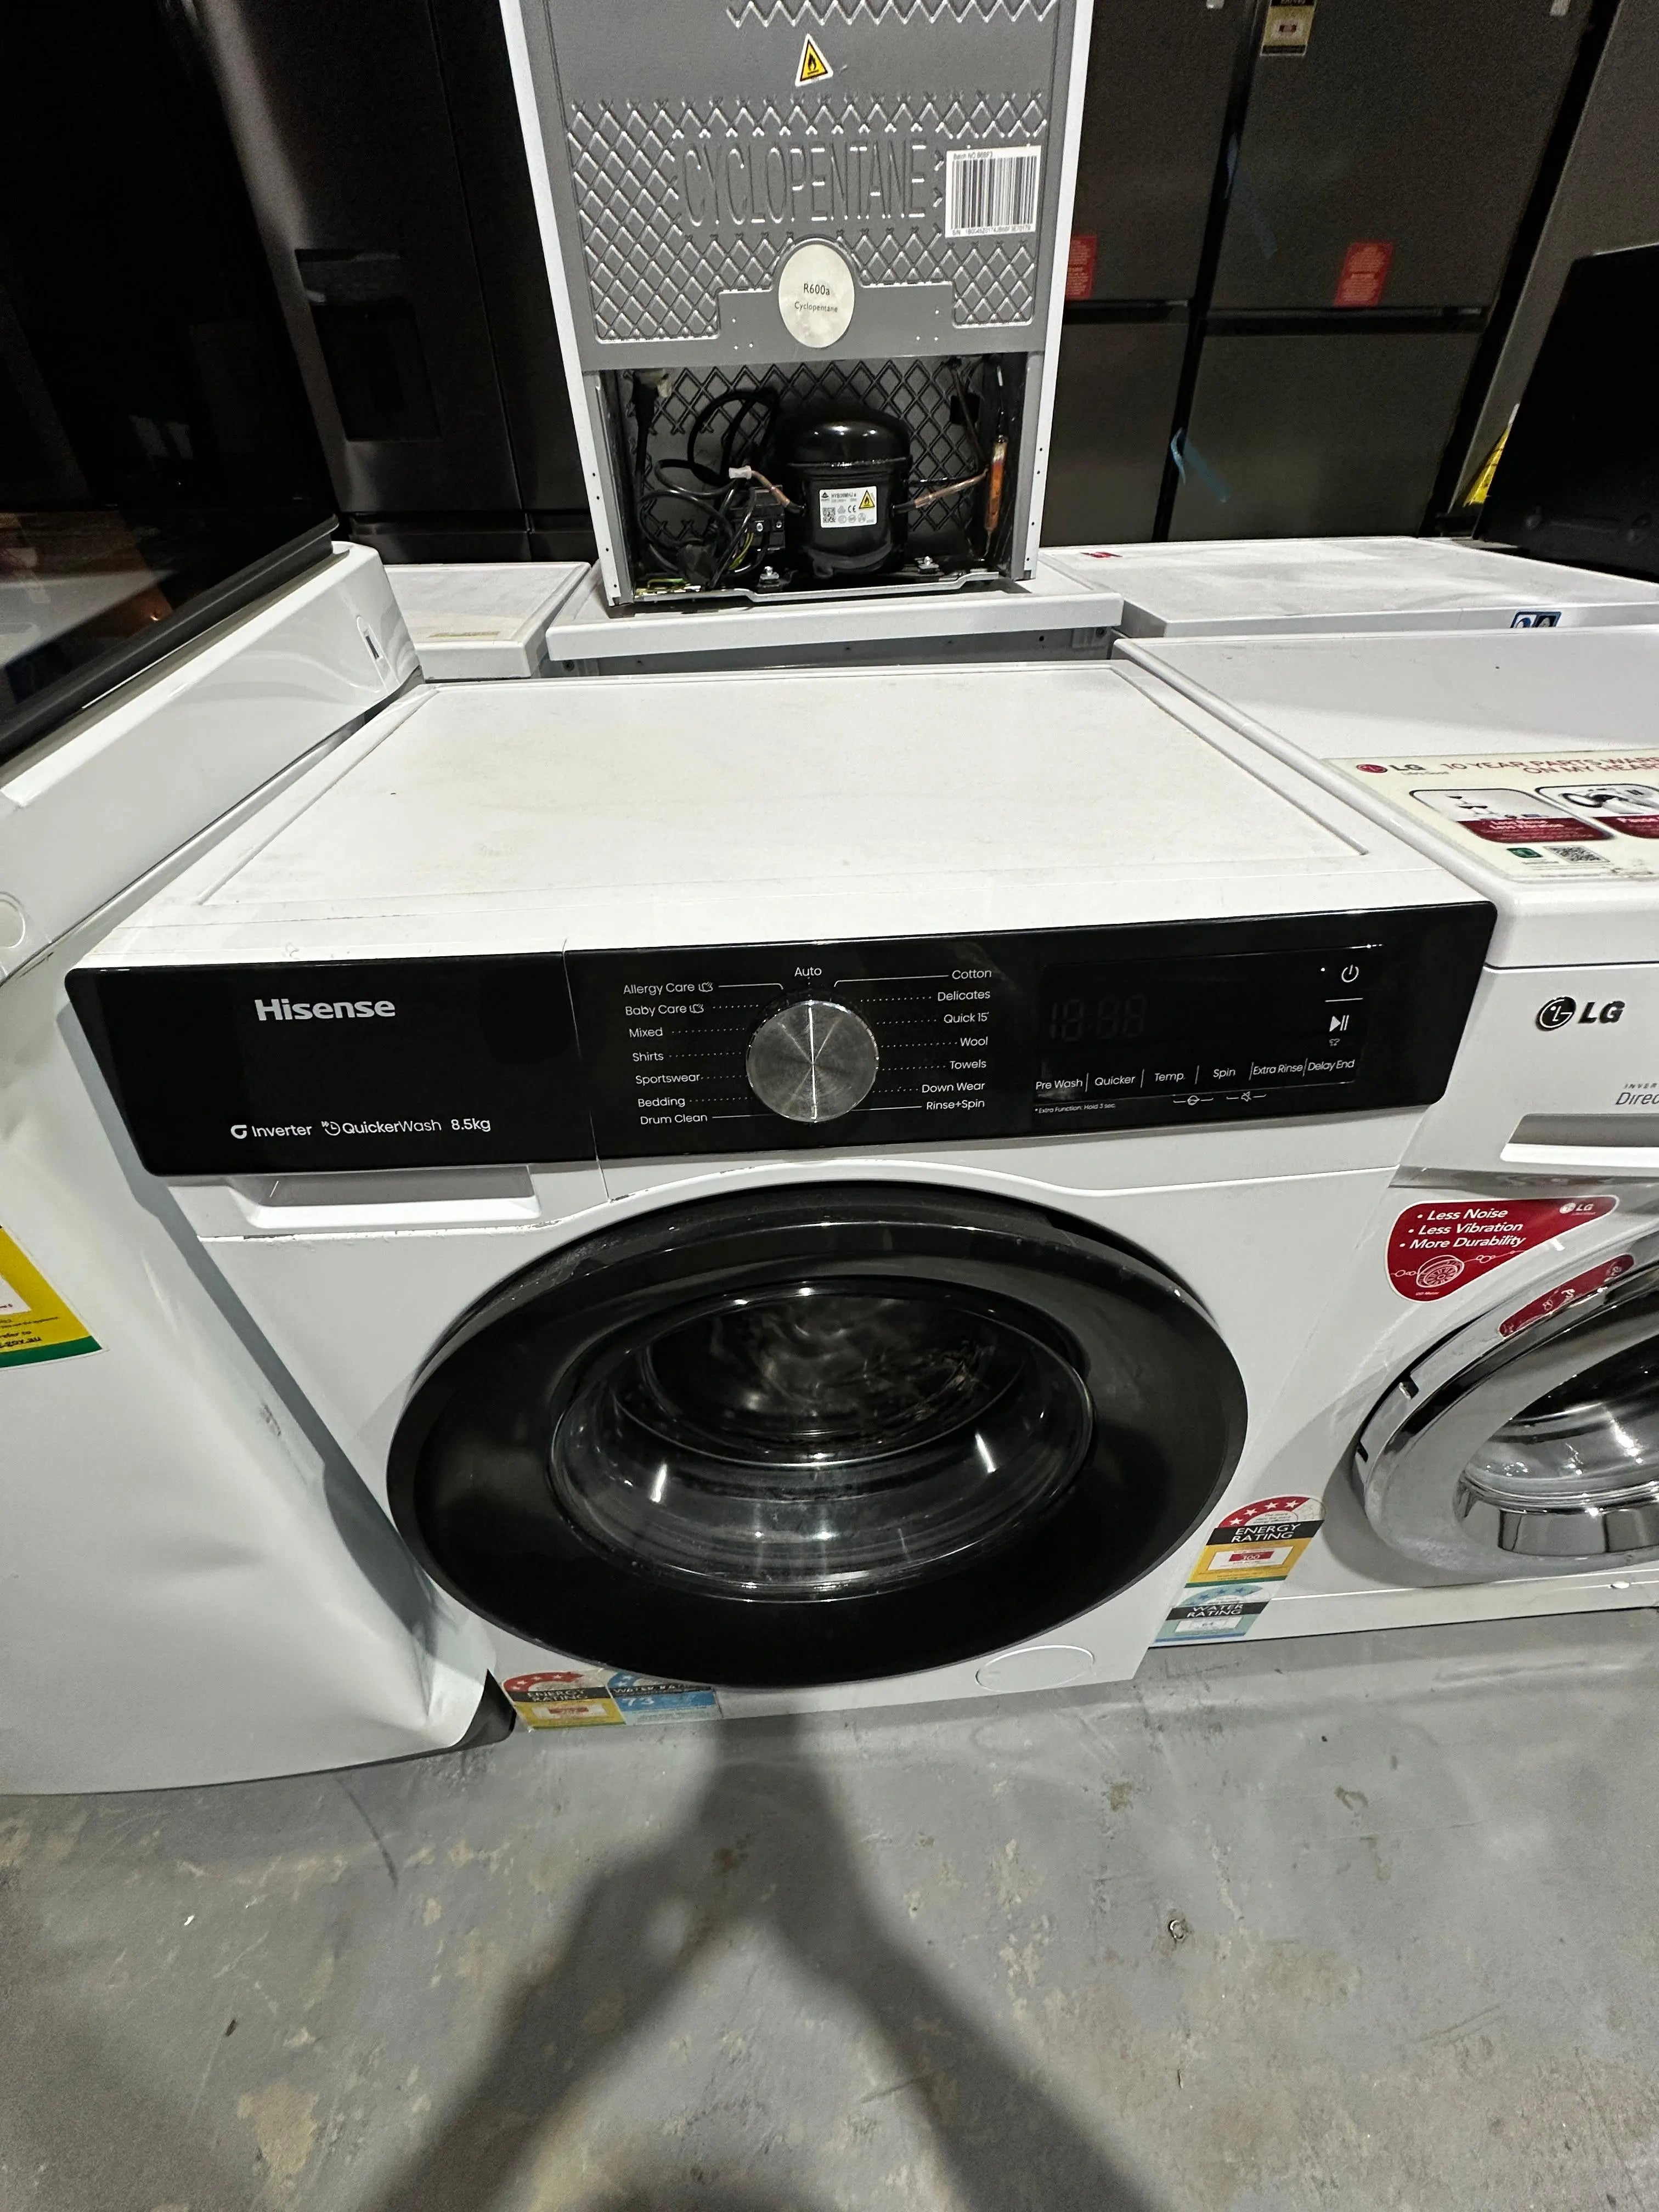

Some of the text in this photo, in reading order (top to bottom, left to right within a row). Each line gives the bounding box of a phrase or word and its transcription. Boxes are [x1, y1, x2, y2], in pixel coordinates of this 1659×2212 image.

[683, 139, 926, 226] CYCLOPENTANE
[804, 283, 830, 296] R600a
[795, 302, 838, 313] Cyclopentane
[794, 967, 822, 977] Auto
[951, 969, 992, 980] Cotton
[623, 983, 695, 996] Allergy Care
[938, 991, 990, 1002] Delicates
[255, 998, 396, 1021] Hisense
[625, 1005, 687, 1017] Baby Care
[1578, 1001, 1626, 1024] LG
[944, 1014, 975, 1024] Quick
[629, 1028, 663, 1038] Mixed
[960, 1036, 988, 1047] Wool
[633, 1052, 664, 1062] Shirts
[950, 1059, 987, 1069] Towels
[1253, 1065, 1304, 1075] Extra Rinse
[1307, 1059, 1355, 1071] Delay End
[635, 1074, 701, 1086] Sportswear
[1213, 1068, 1236, 1080] Spin
[1036, 1079, 1083, 1090] Pre Wash
[1094, 1075, 1136, 1086] Quicker
[922, 1082, 985, 1093] Down Wear
[637, 1097, 686, 1108] Bedding
[1615, 1092, 1659, 1105] Direc
[926, 1099, 985, 1111] Rinse+Spin
[640, 1113, 708, 1125] Drum Clean
[252, 1118, 491, 1137] Inverter QuickerWash 8.5kg
[1427, 1208, 1508, 1220] Less Noise
[1418, 1222, 1523, 1235] Less Vibration
[1409, 1235, 1527, 1249] More Durability
[1235, 1523, 1301, 1535] ENERGY
[1231, 1532, 1294, 1543] RATING
[1187, 1610, 1242, 1618] RATING
